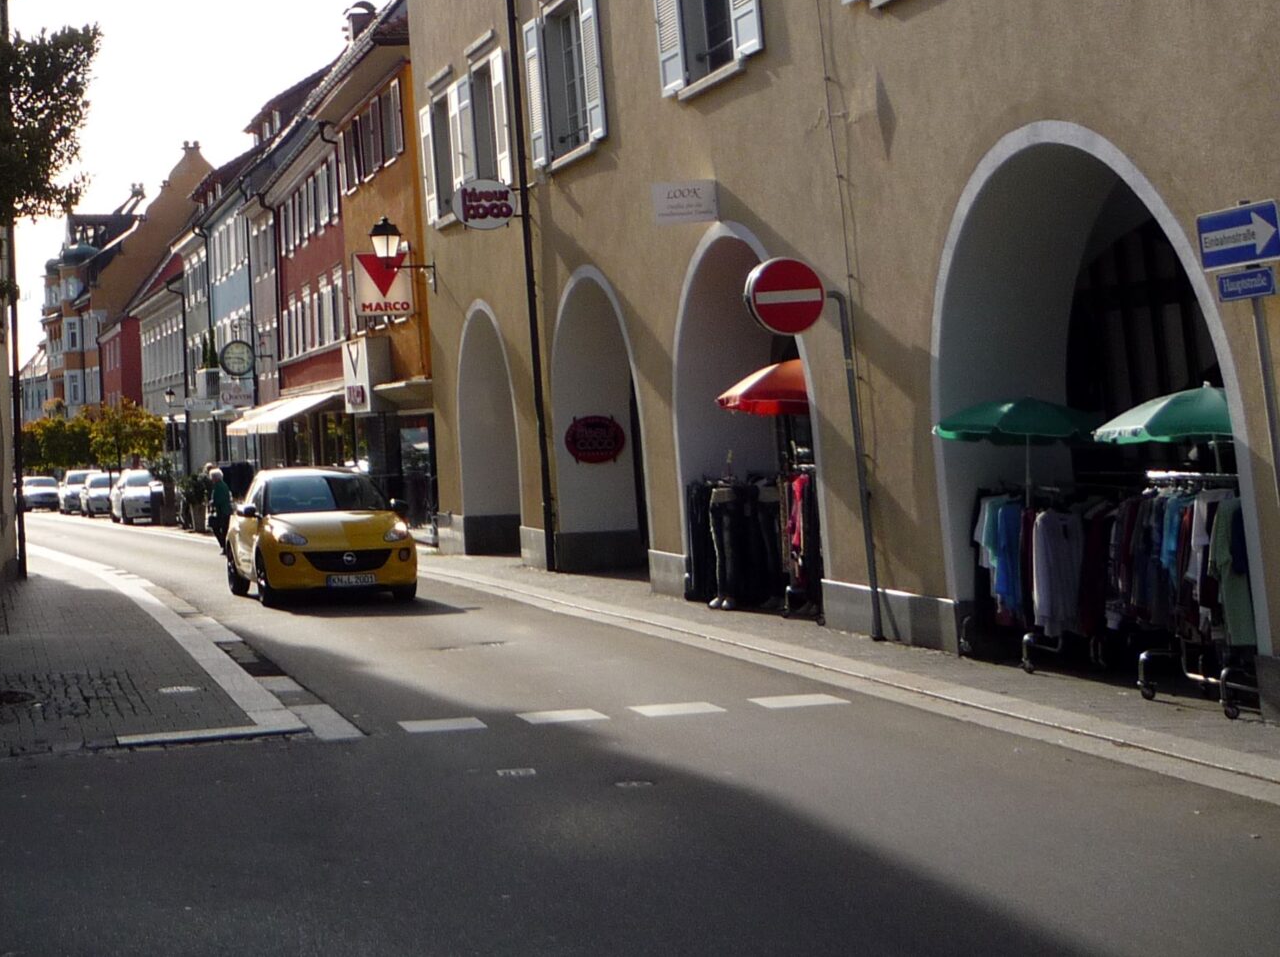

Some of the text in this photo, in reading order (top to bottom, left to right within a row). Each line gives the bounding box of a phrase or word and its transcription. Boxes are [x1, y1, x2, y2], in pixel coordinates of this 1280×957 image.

[666, 187, 703, 199] LOOK
[1203, 228, 1257, 249] Einbahnstraße
[1222, 272, 1268, 294] Hauptstraße
[361, 301, 410, 313] MARCO
